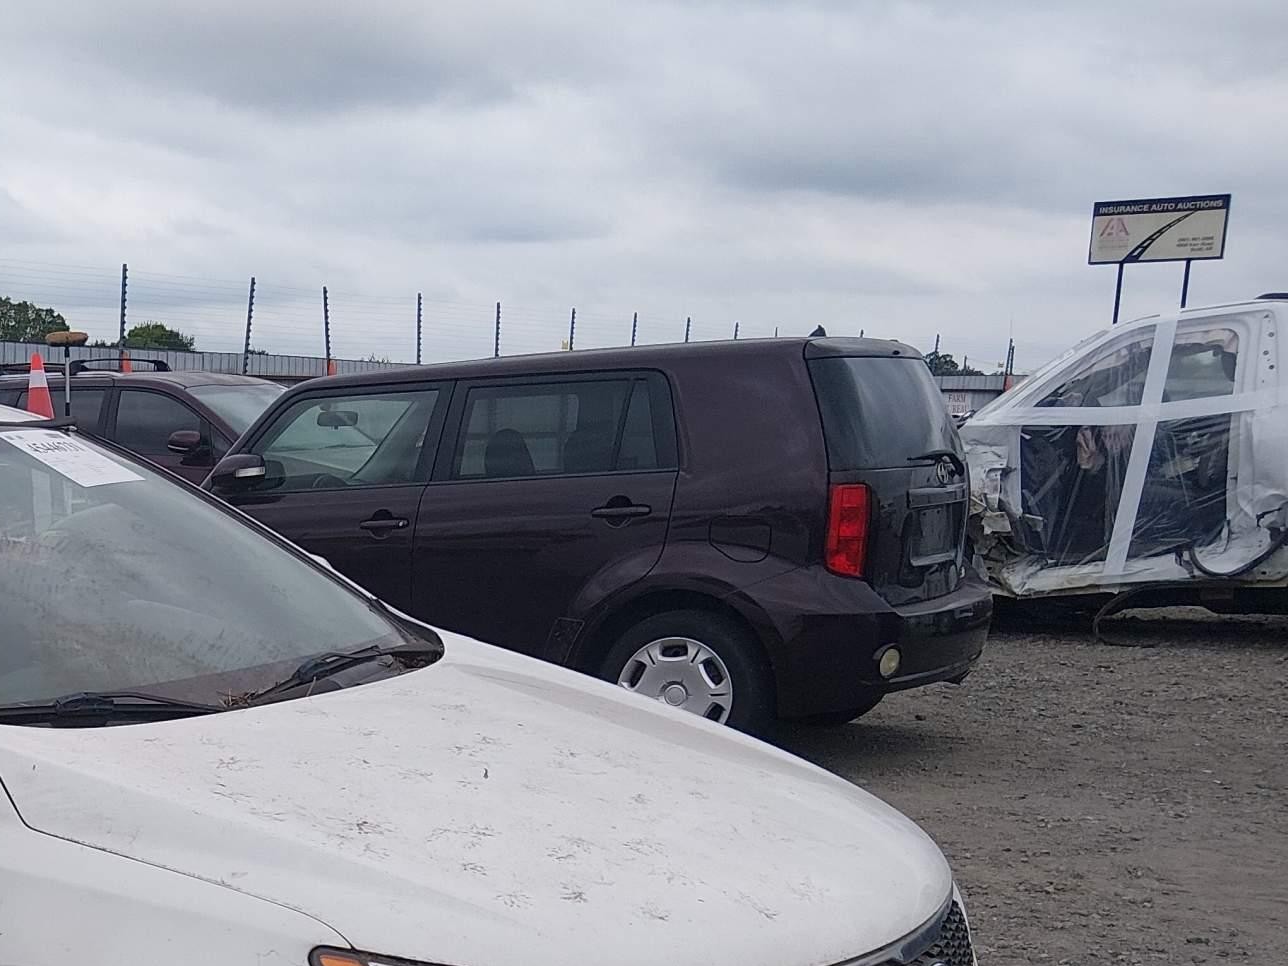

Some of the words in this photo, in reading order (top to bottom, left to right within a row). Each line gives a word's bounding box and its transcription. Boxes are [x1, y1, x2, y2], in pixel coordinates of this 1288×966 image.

[1099, 203, 1149, 214] INSURANCE
[1150, 202, 1175, 212] AUTO
[1176, 199, 1223, 210] AUCTIONS
